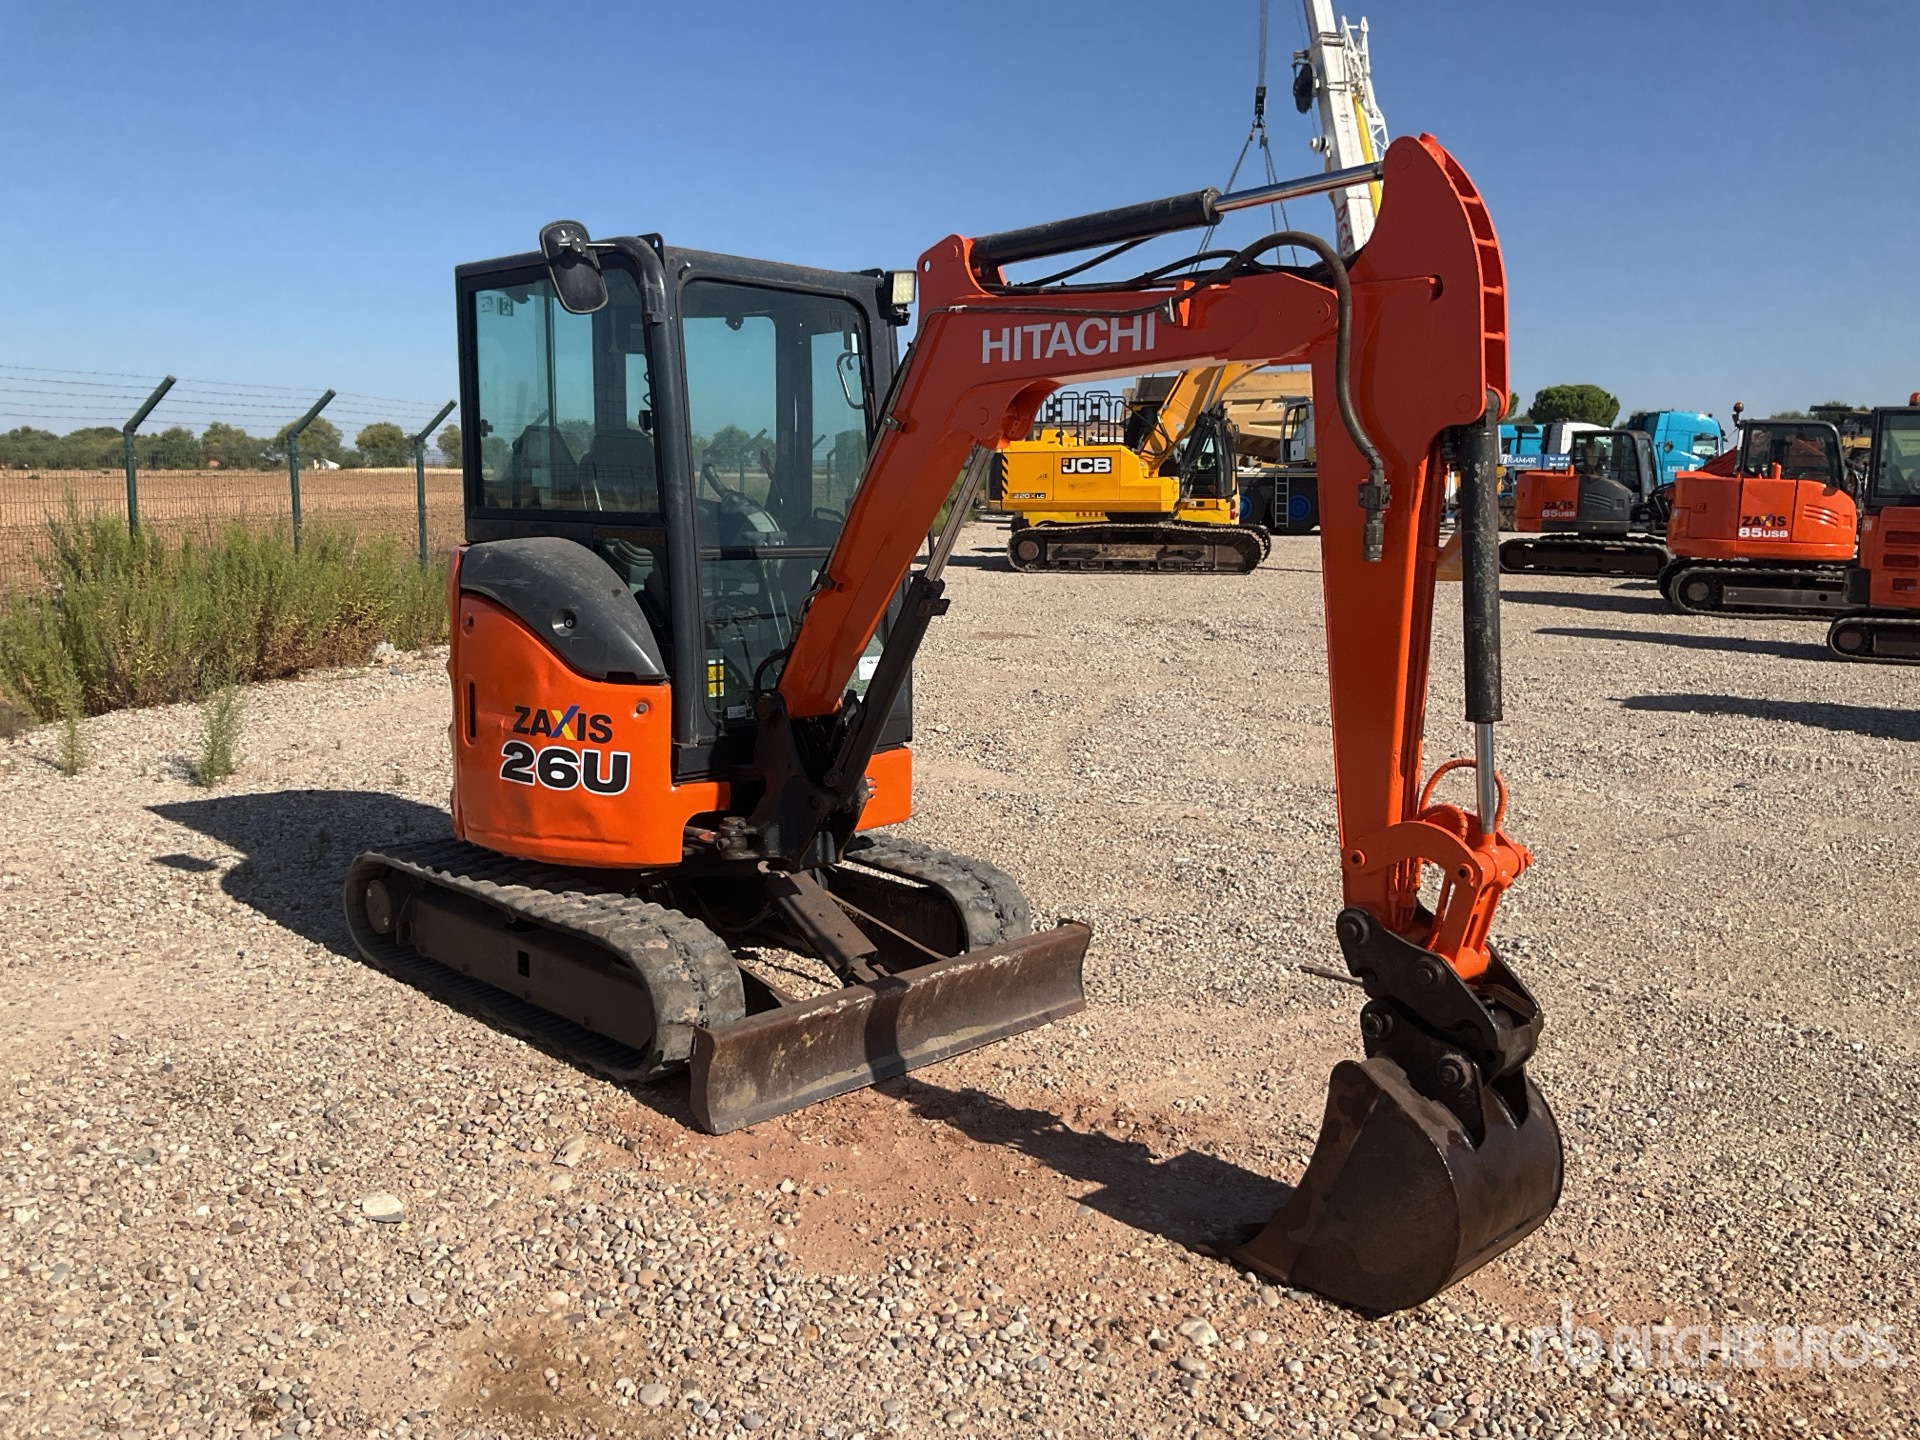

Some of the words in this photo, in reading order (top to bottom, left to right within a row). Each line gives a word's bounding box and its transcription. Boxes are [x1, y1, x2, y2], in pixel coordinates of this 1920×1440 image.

[982, 312, 1156, 364] HITACHI
[1062, 458, 1111, 473] JCB
[1543, 499, 1574, 510] ZAXIS
[1741, 512, 1787, 527] ZAXIS
[1738, 527, 1789, 538] 85USB
[512, 704, 613, 744] ZAXIS
[499, 739, 631, 796] 26U
